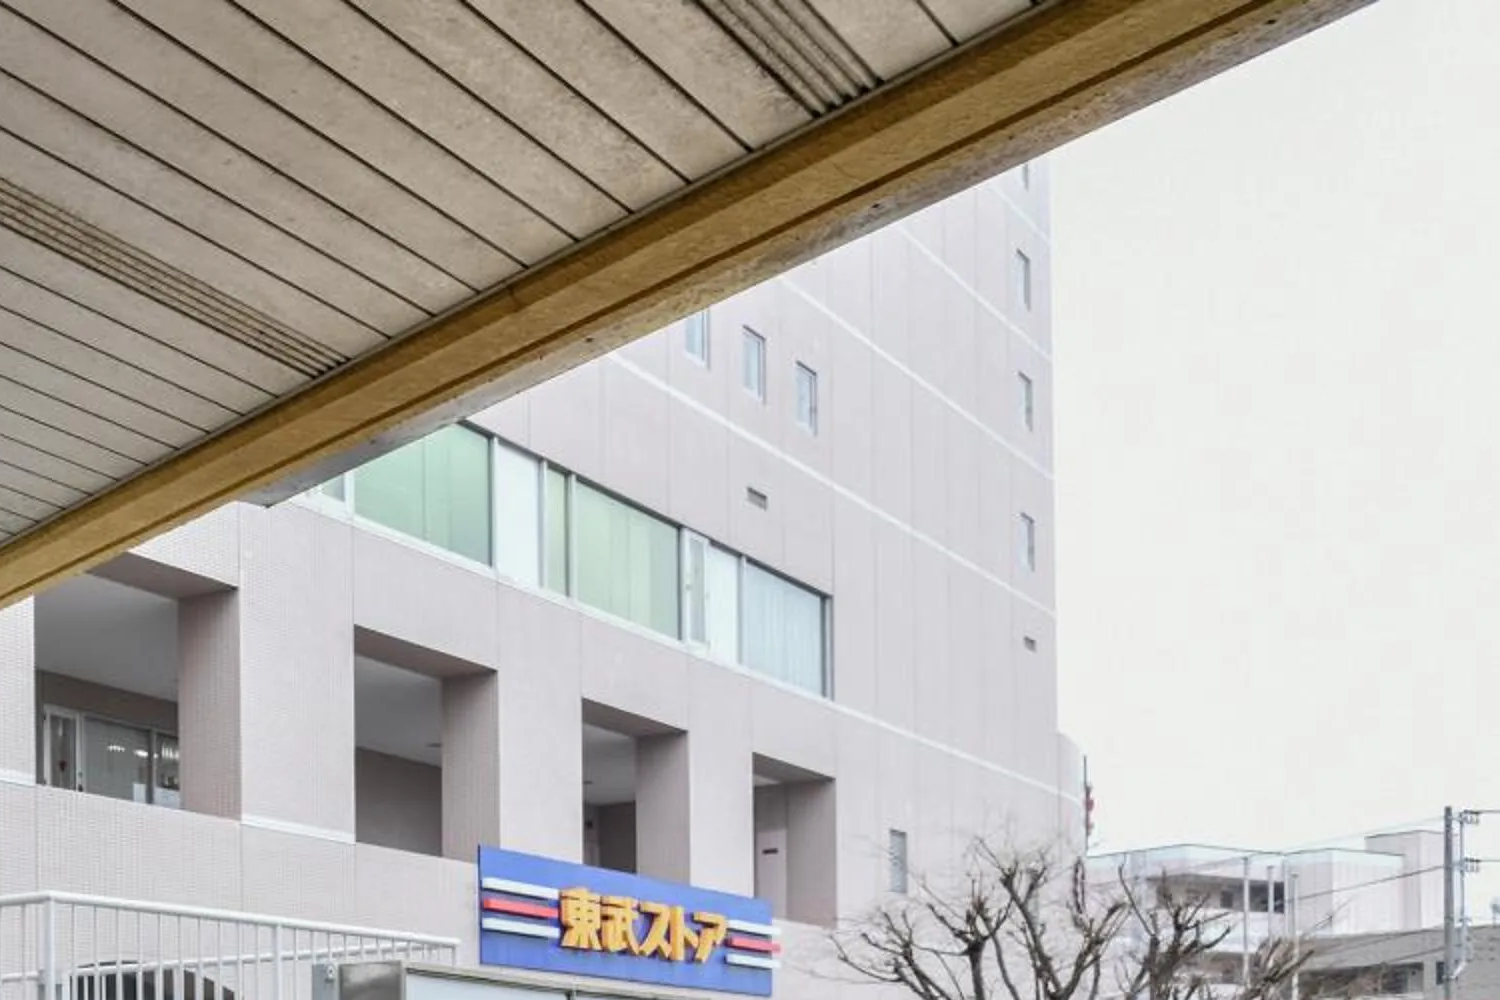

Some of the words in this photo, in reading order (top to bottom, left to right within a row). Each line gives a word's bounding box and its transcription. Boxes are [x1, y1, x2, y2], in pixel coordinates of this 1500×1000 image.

[560, 886, 729, 963] 東武ストア
